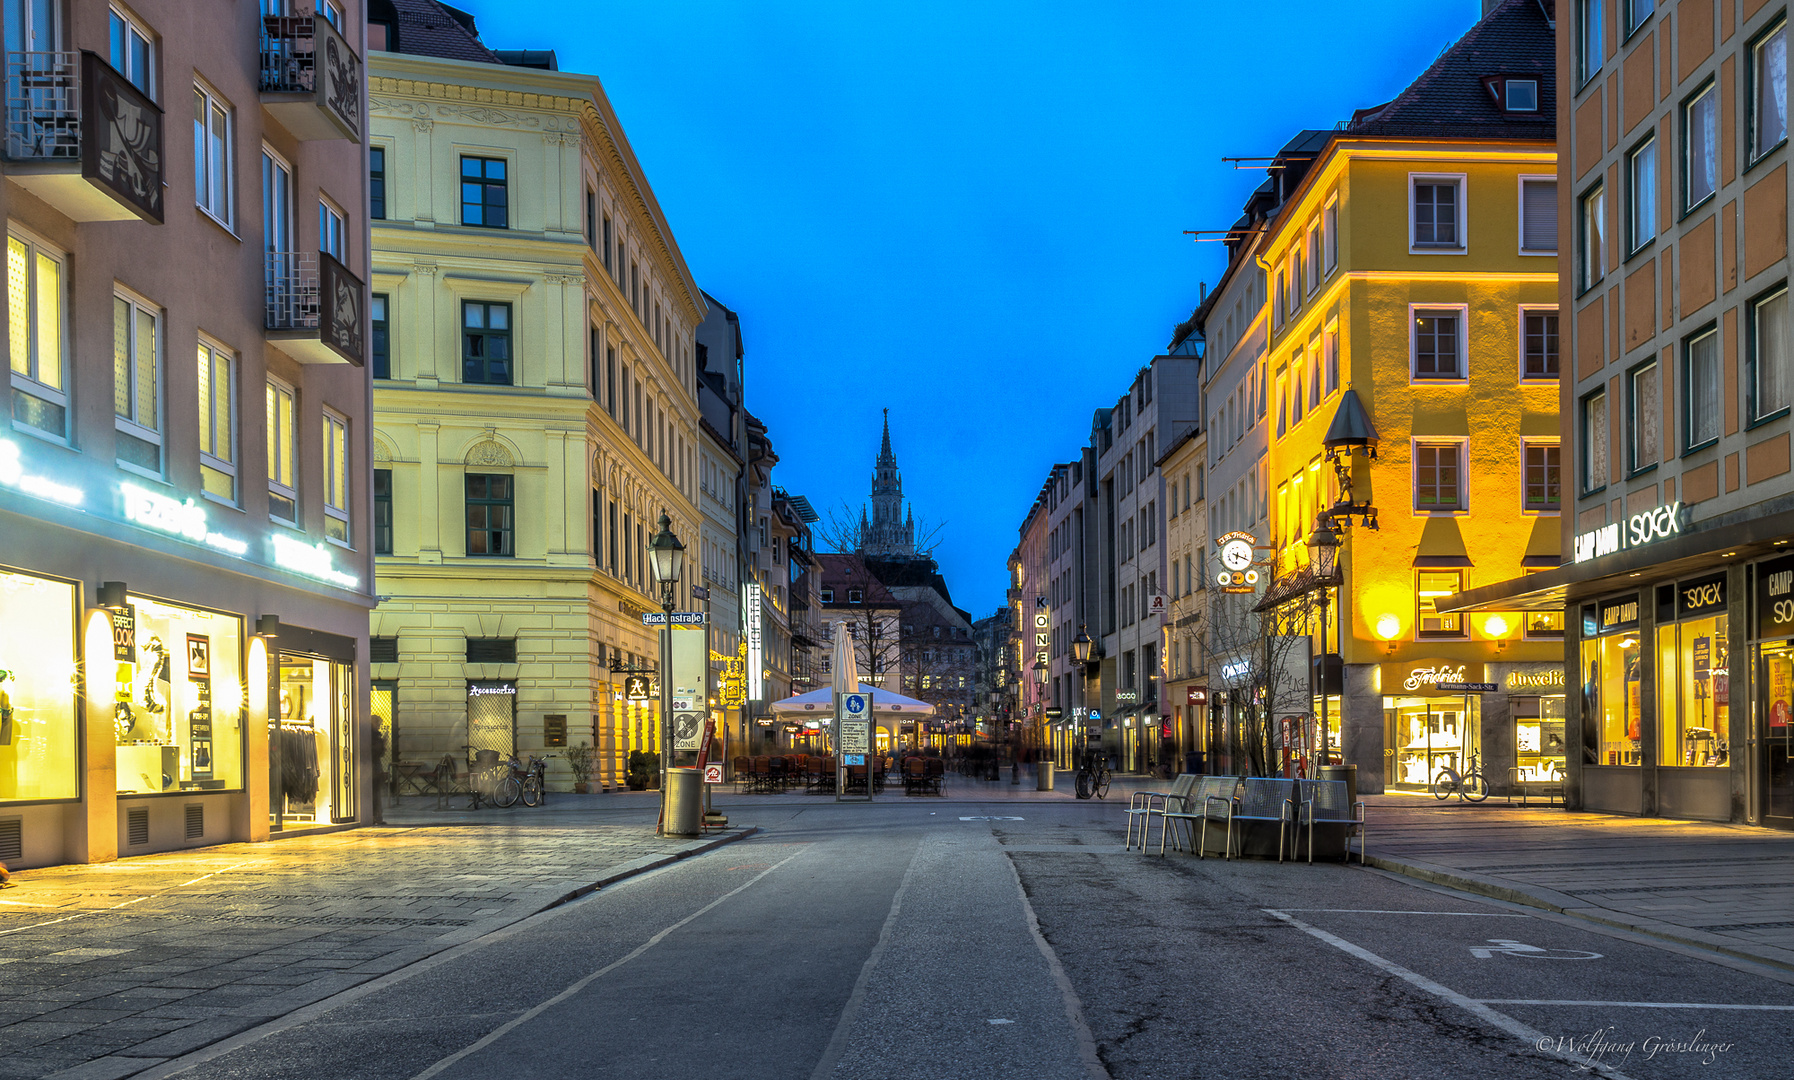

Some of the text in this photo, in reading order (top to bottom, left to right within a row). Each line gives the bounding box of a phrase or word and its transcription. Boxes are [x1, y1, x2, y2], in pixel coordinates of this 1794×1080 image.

[1769, 570, 1793, 596] CAMP
[645, 613, 701, 623] Hacknstraße
[1604, 602, 1637, 626] CAMP DAVID
[1774, 599, 1794, 624] SO
